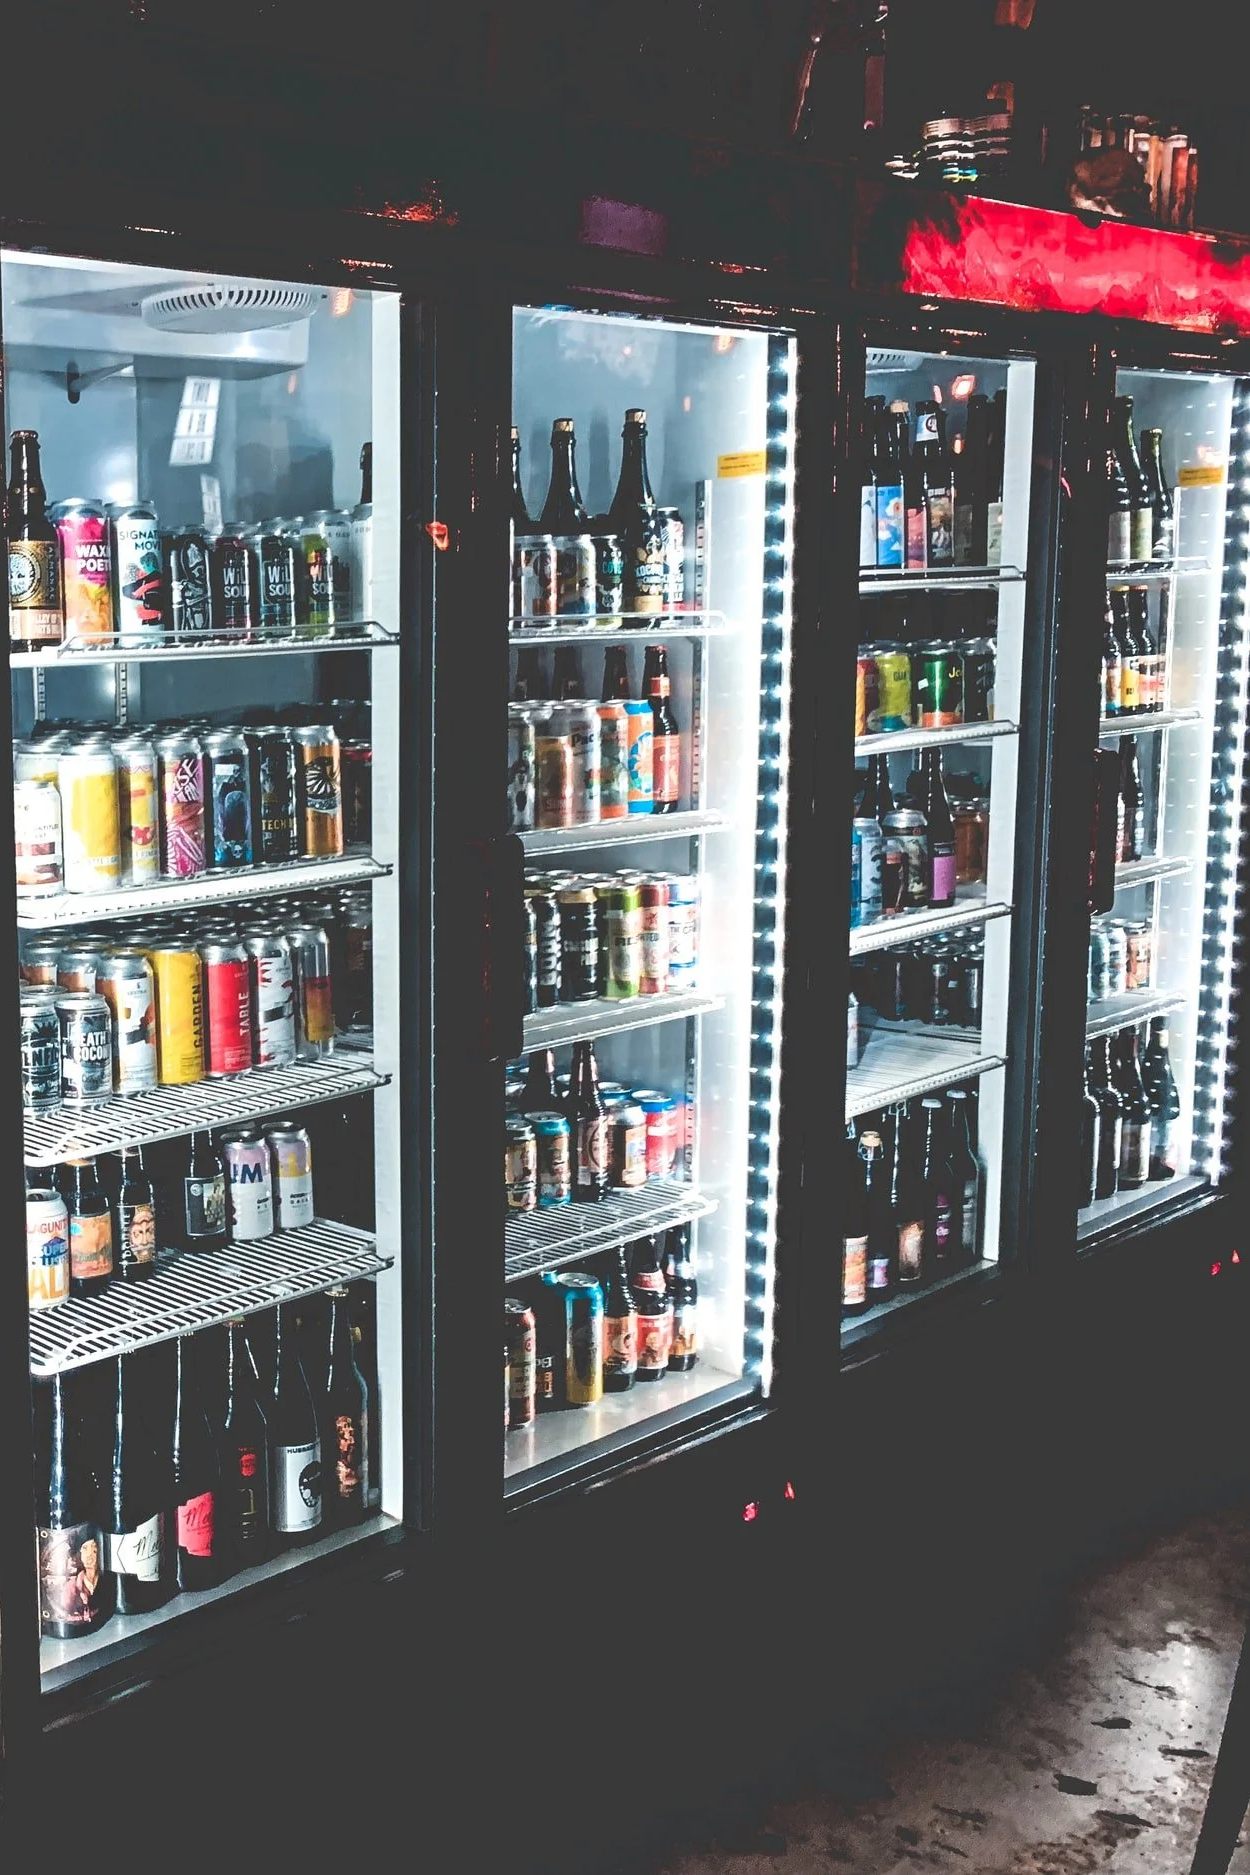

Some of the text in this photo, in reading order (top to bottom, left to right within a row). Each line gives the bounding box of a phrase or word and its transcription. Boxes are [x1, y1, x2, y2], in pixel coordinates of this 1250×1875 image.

[75, 544, 107, 558] WAX
[223, 584, 248, 599] SOU
[268, 583, 291, 598] SOU
[192, 983, 202, 1049] GARDEN
[239, 991, 250, 1037] TABLE
[74, 1030, 108, 1048] EATH
